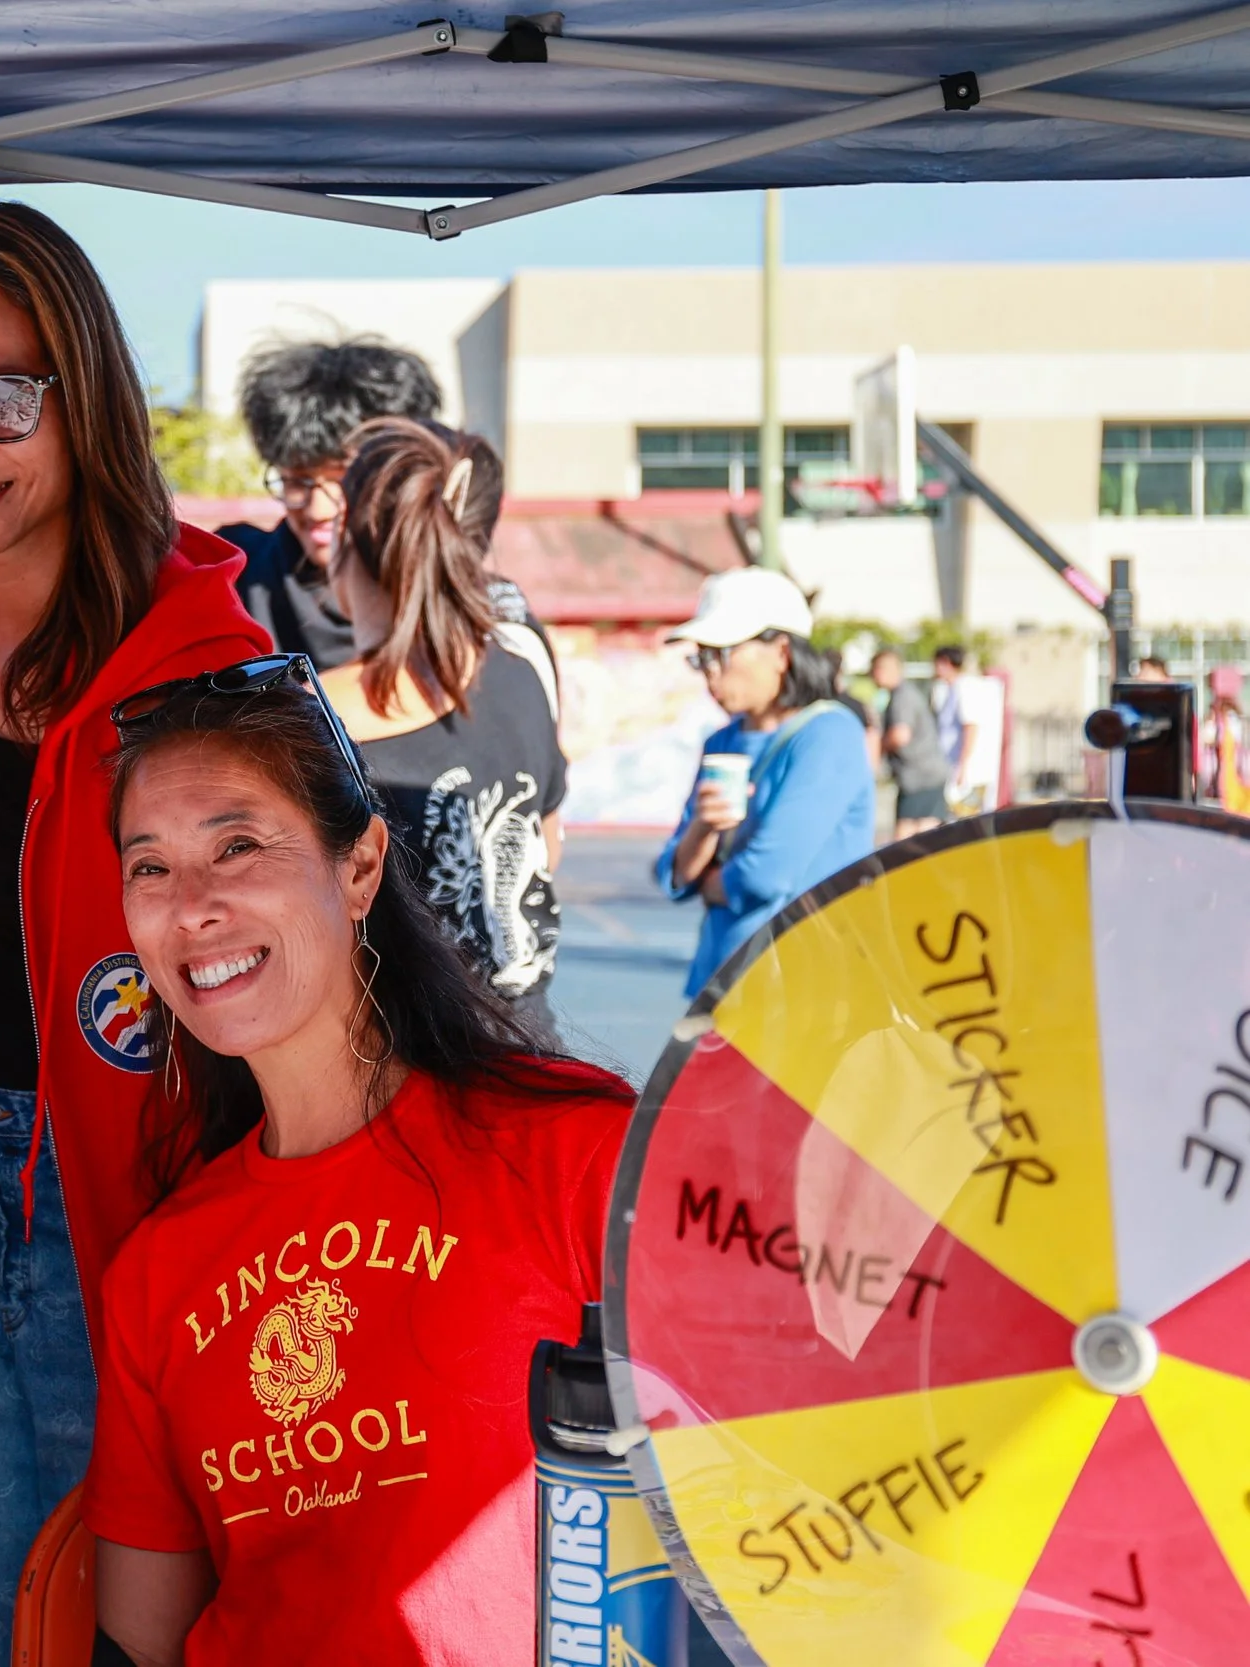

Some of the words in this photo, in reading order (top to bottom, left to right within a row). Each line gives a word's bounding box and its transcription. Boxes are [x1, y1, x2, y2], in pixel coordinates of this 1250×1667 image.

[84, 1022, 94, 1030] A
[917, 911, 1058, 1225] STICKER
[184, 1218, 459, 1354] LINCOLN
[676, 1178, 948, 1319] MAGNET
[201, 1400, 427, 1492] SCHOOL
[284, 1471, 363, 1517] Oakland
[550, 1486, 603, 1667] RIORS
[739, 1437, 985, 1595] STUFFIE
